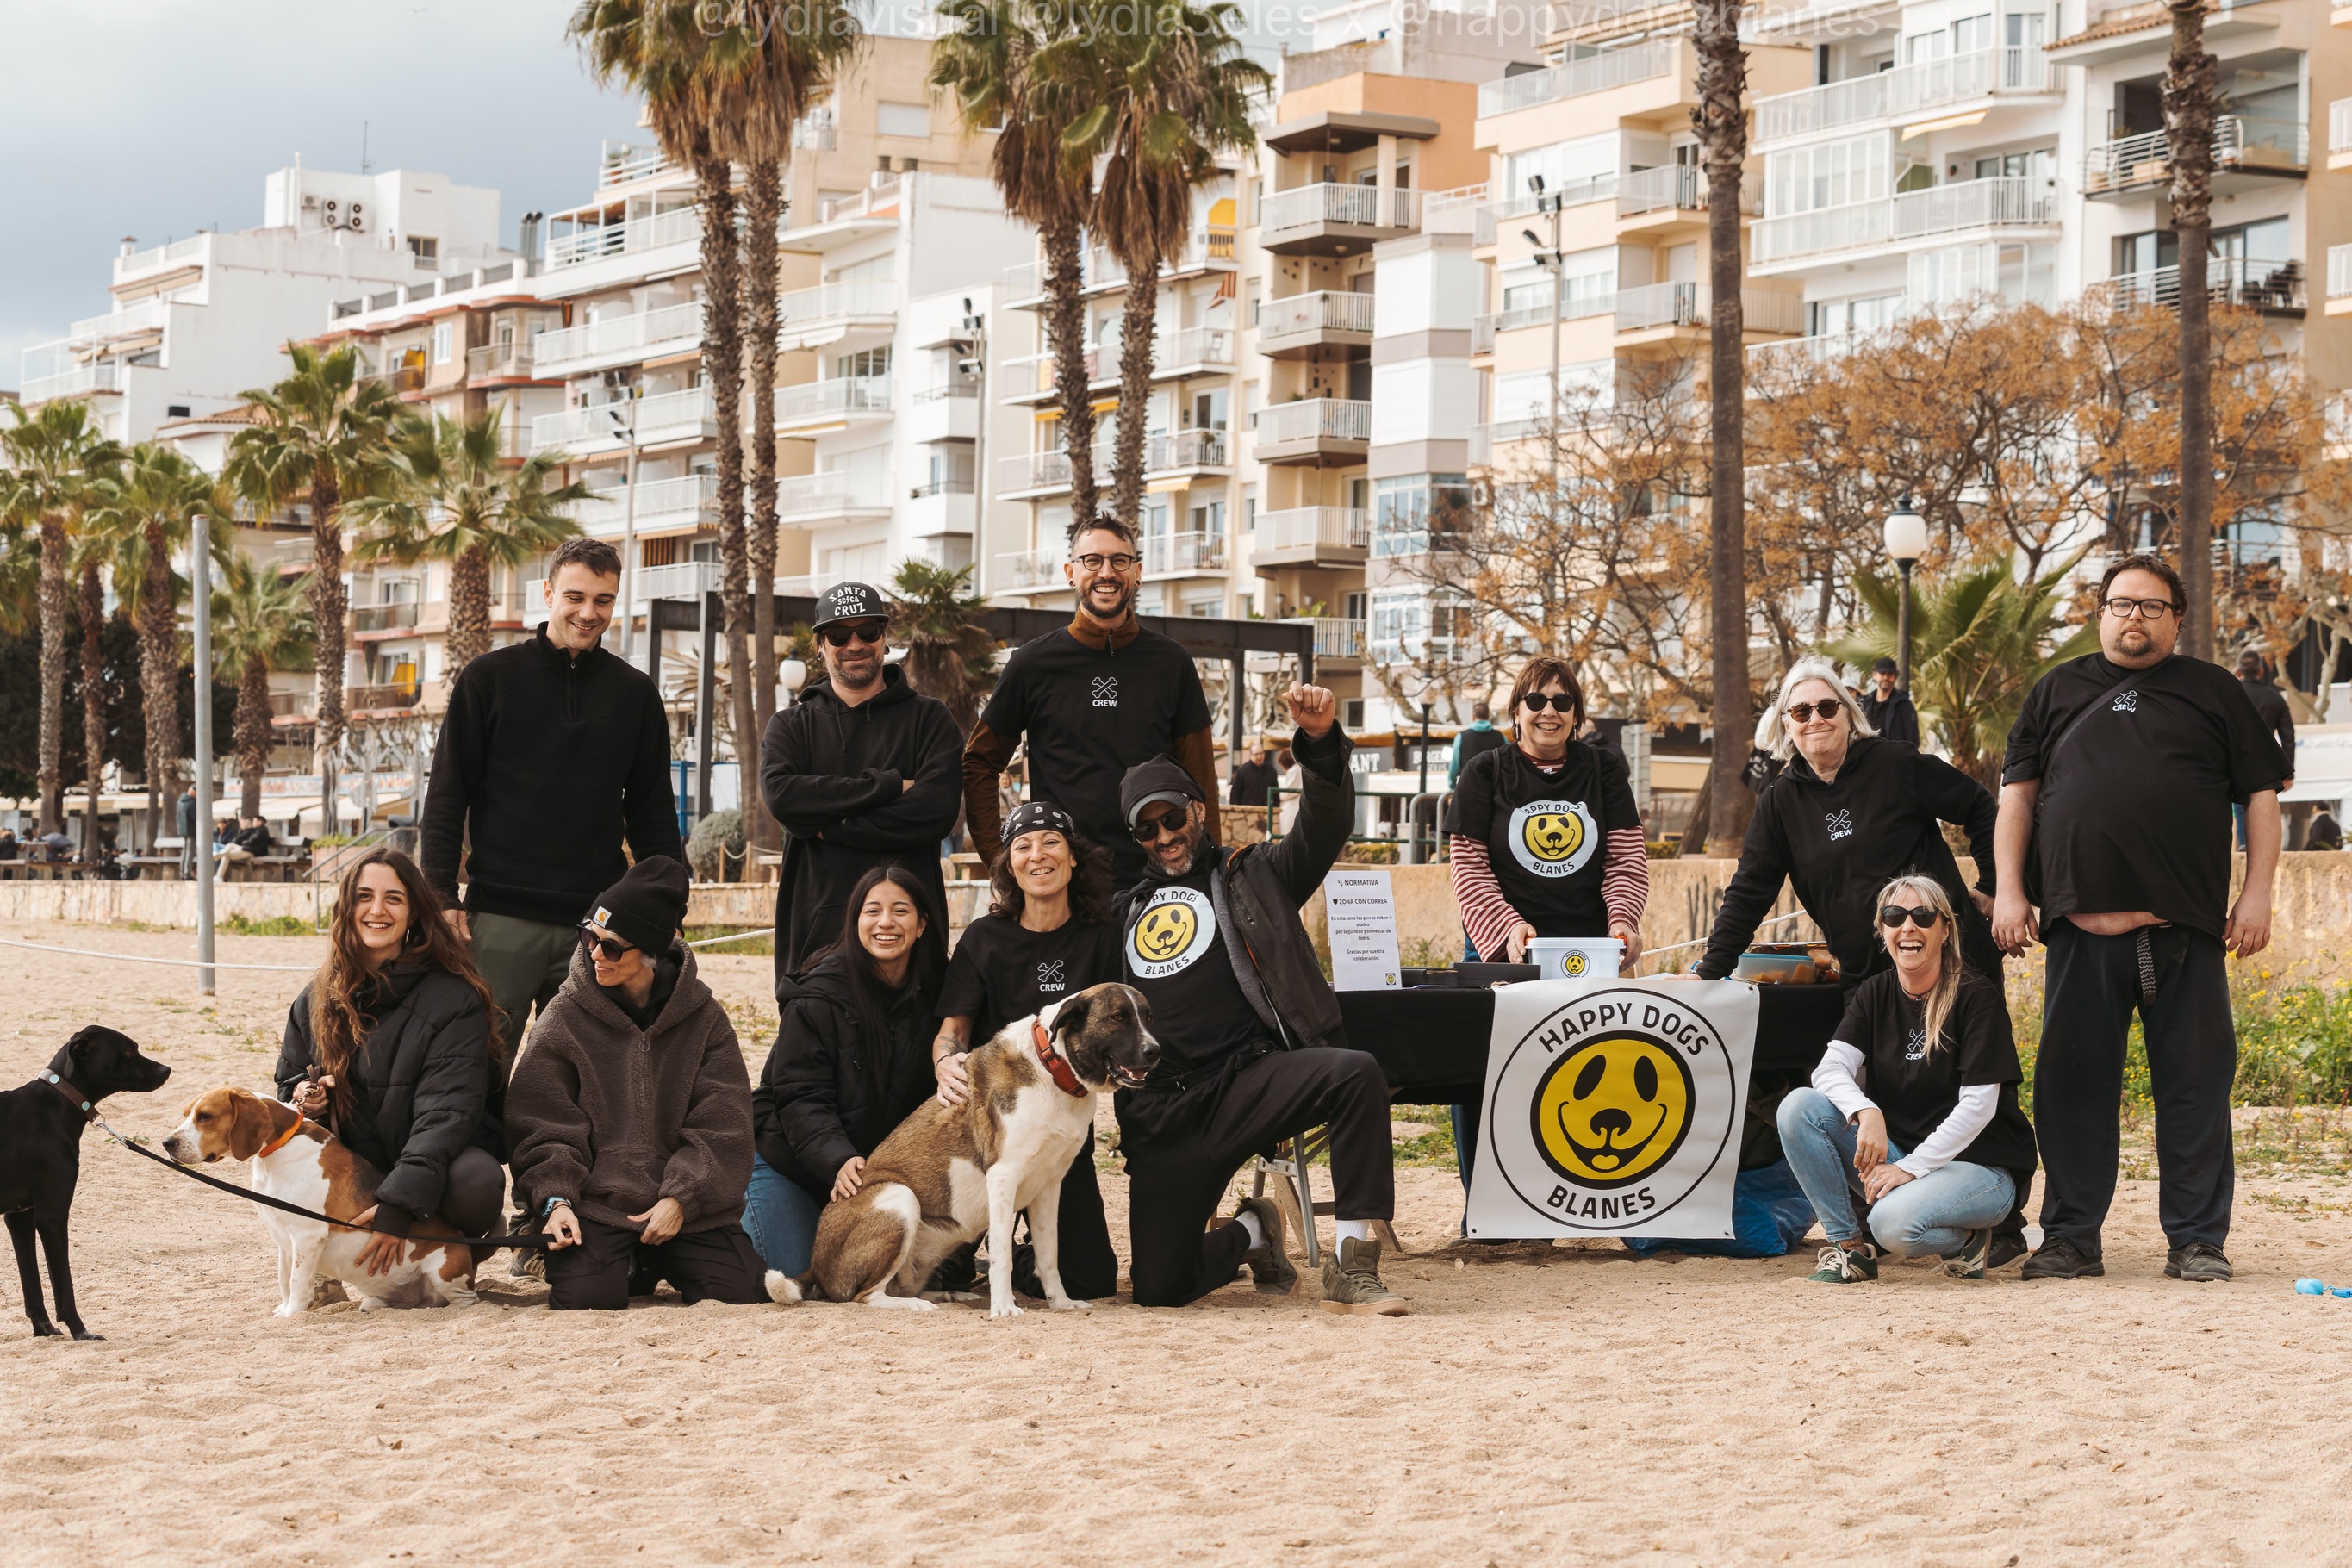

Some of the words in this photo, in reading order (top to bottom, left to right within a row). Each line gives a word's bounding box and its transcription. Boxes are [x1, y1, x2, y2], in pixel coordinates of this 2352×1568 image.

[829, 586, 867, 602] SANTA
[834, 602, 867, 616] CRUZ
[2112, 704, 2136, 712] CREW
[1522, 804, 1551, 814] APPY
[1830, 828, 1853, 841] CREW
[1532, 861, 1575, 874] BLANES
[1144, 955, 1190, 975] BLANES
[1039, 983, 1065, 992] CREW
[1538, 1002, 1633, 1054] HAPPY
[1642, 1005, 1710, 1055] DOGS
[1546, 1184, 1656, 1220] BLANES
